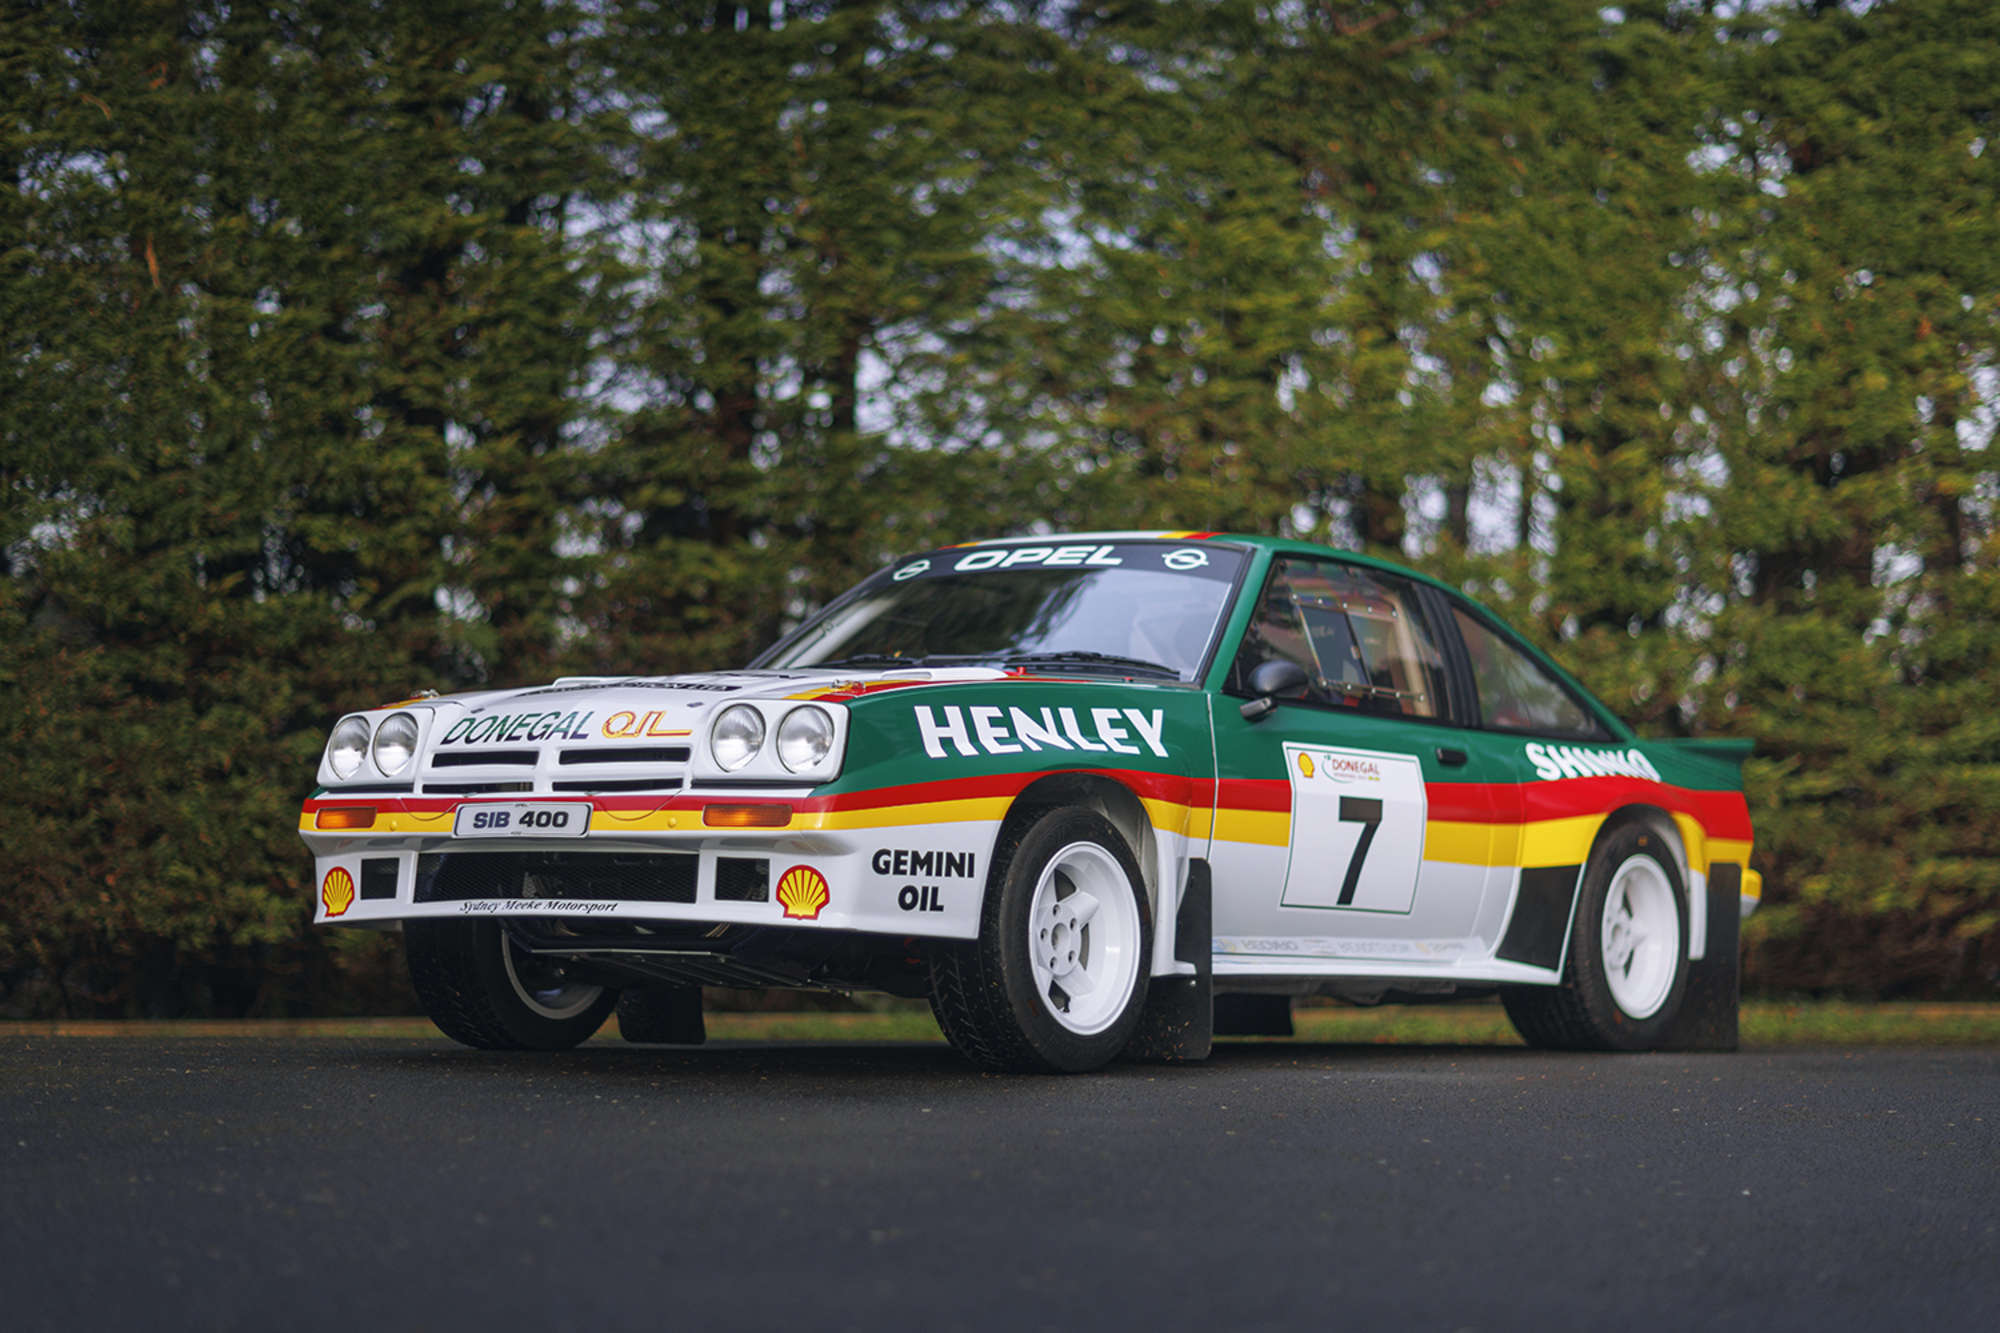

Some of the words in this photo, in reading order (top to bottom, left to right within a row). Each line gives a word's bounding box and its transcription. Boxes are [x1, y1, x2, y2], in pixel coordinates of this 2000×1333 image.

[954, 545, 1122, 571] OPEL
[440, 711, 595, 745] DONEGAL
[914, 705, 1169, 759] HENLEY
[1332, 758, 1381, 775] DONEGAL
[473, 811, 510, 828] SIB
[519, 811, 569, 828] 400
[872, 848, 975, 878] GEMINI
[1336, 795, 1383, 905] 7
[459, 901, 499, 914] Sydney
[502, 900, 542, 910] Meeke
[543, 900, 619, 913] Motorsport
[898, 885, 944, 912] OIL
